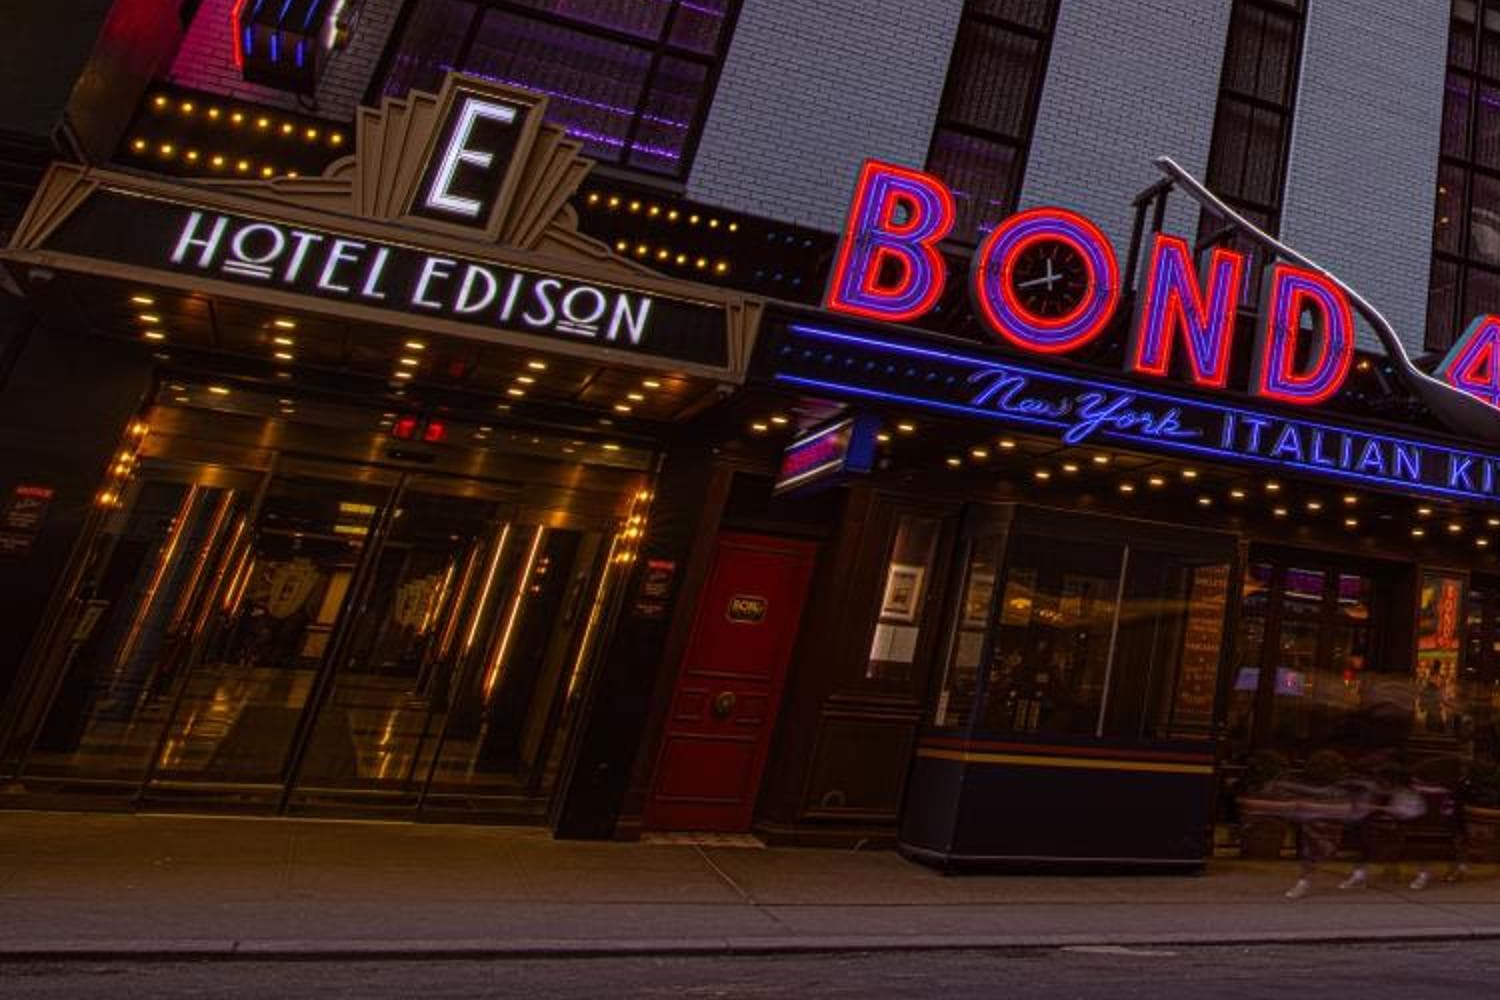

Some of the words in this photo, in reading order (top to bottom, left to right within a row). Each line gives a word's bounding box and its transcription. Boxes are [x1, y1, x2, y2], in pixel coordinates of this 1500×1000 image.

[425, 98, 517, 217] E
[171, 211, 387, 300] HOTEL
[412, 258, 652, 346] EDISON
[829, 157, 1355, 405] BOND
[1063, 391, 1200, 445] York
[1221, 411, 1422, 481] ITALIAN
